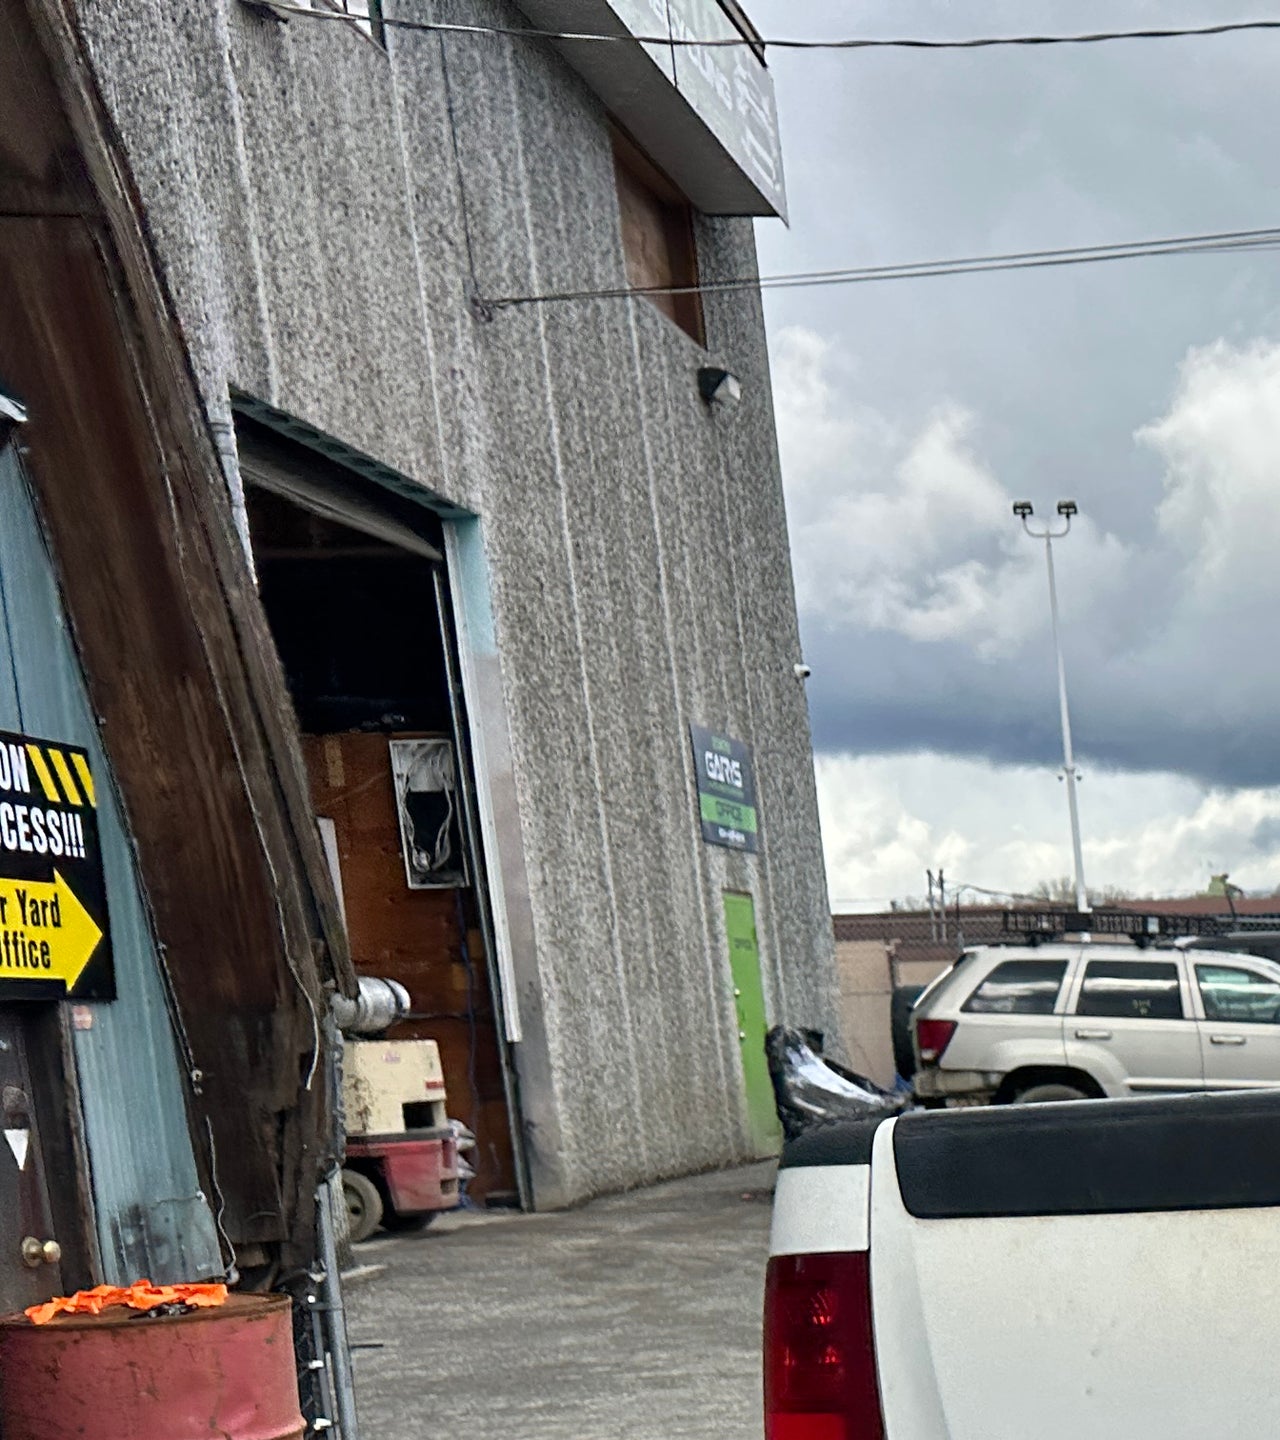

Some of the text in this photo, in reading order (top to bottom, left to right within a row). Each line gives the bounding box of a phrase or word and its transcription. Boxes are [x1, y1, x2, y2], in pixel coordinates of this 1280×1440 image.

[0, 802, 85, 858] CESS!!!
[15, 889, 62, 928] Yard
[0, 930, 51, 969] ffice
